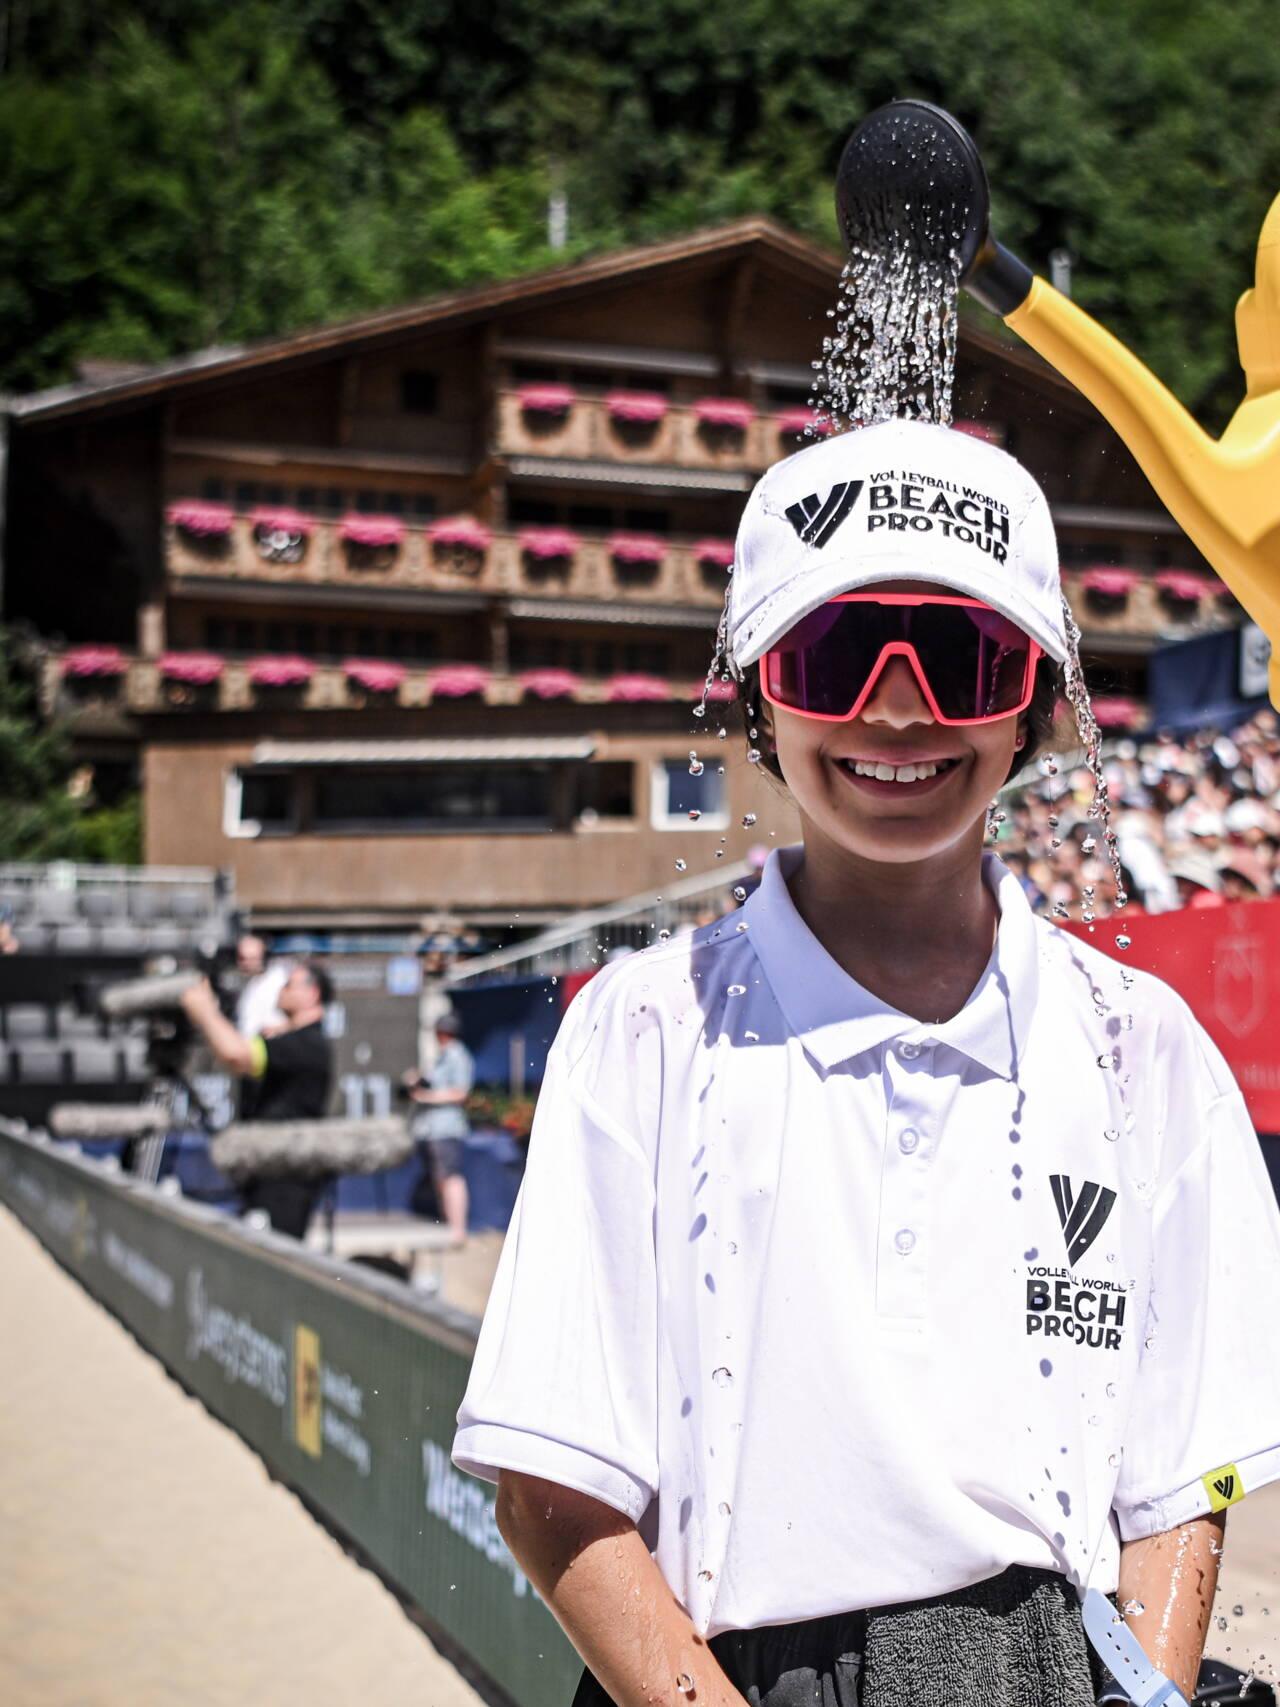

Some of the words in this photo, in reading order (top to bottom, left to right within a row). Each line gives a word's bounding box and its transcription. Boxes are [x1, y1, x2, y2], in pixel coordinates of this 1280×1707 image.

[869, 483, 1009, 545] BEACH
[962, 486, 1009, 515] WORLD
[867, 513, 933, 532] PRO
[938, 519, 1007, 566] TOUR
